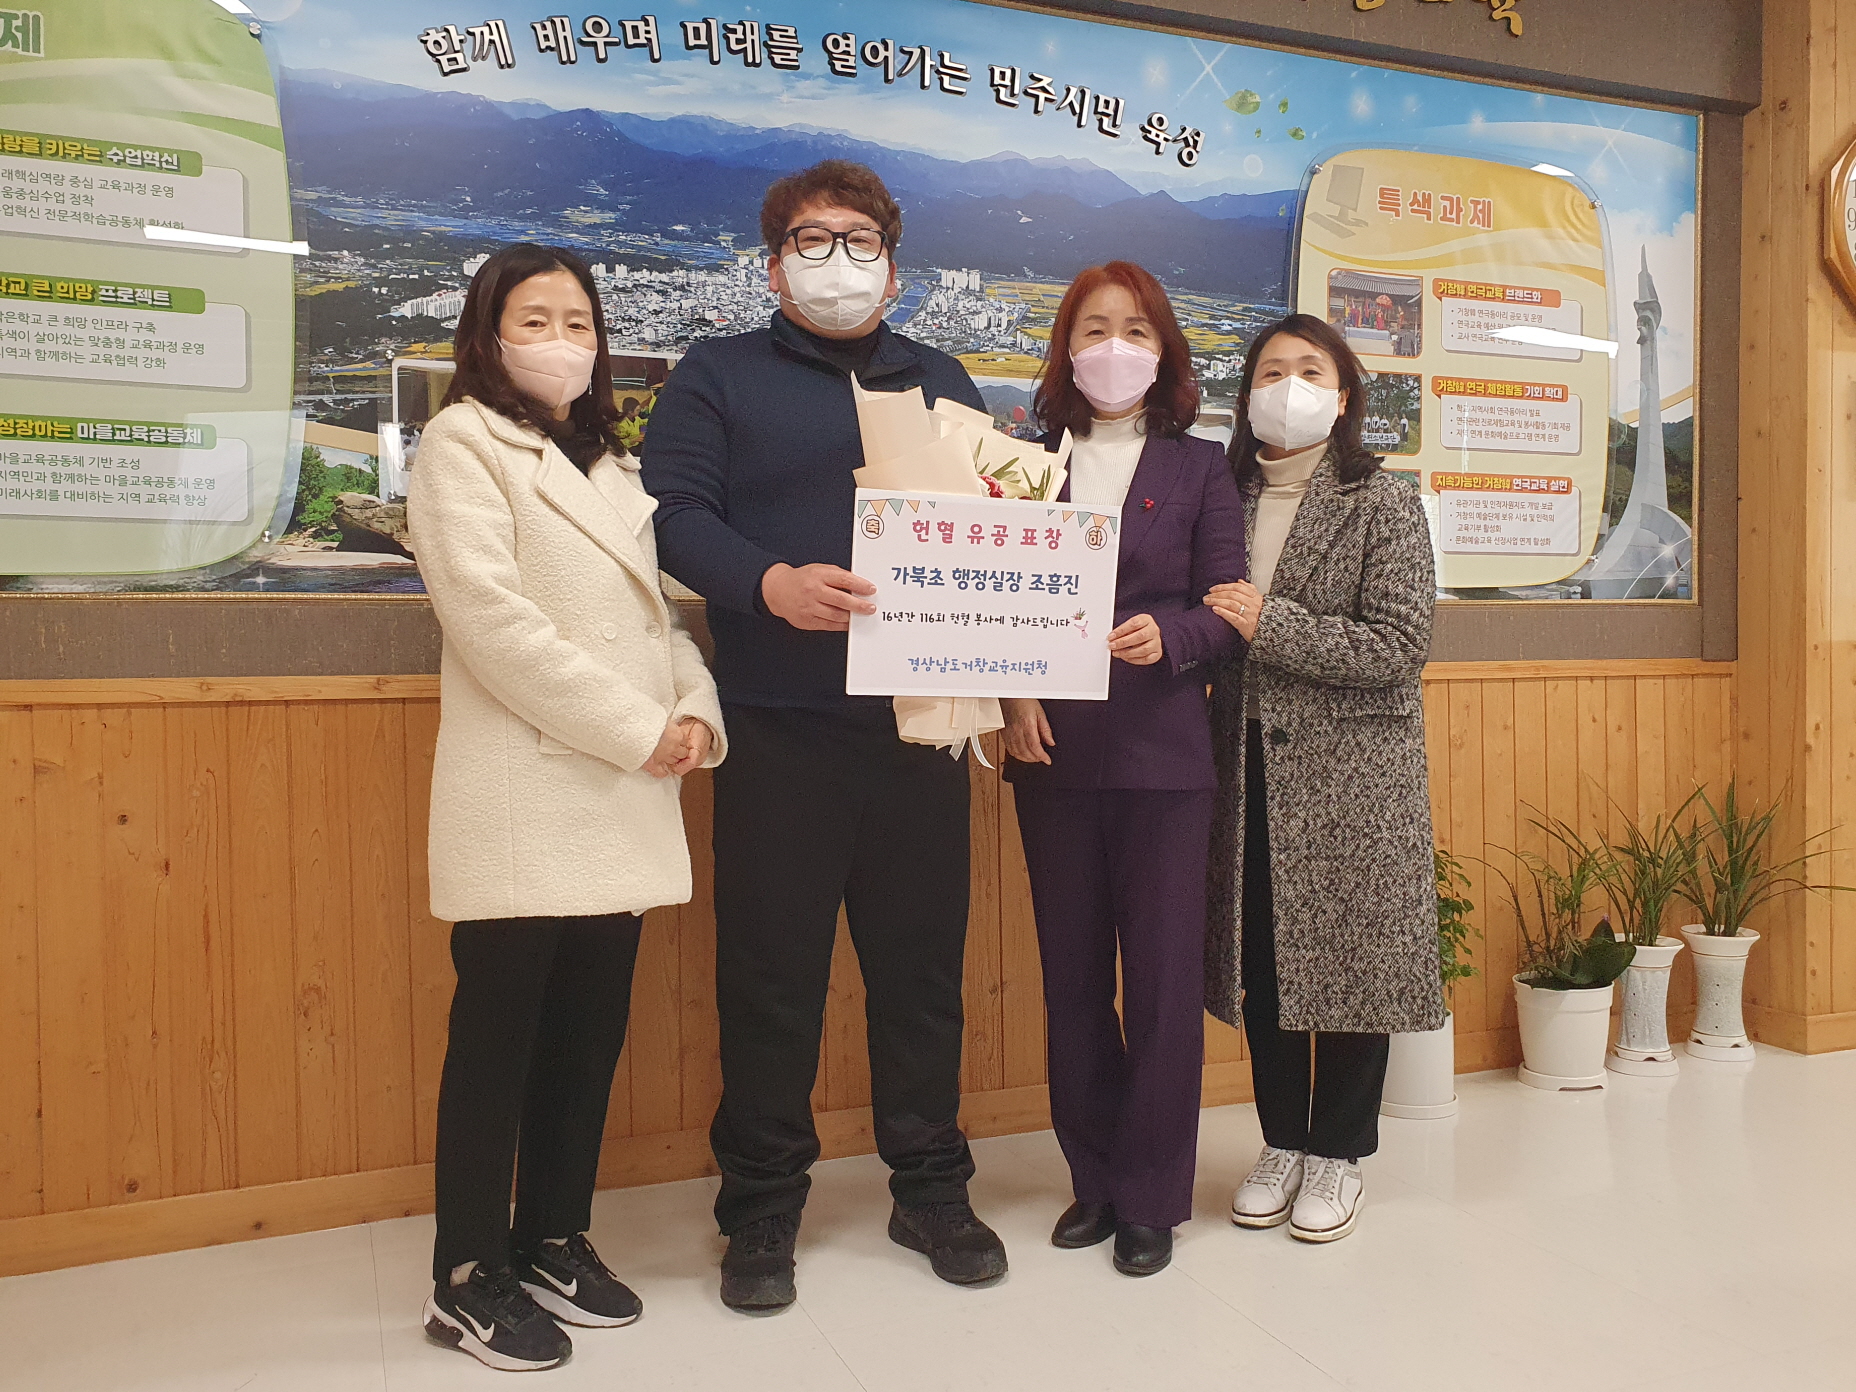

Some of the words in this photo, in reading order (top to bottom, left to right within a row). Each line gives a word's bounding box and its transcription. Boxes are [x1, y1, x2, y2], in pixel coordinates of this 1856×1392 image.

[418, 19, 517, 77] 함께
[530, 14, 662, 65] 배우며
[680, 17, 804, 70] 미래를
[821, 32, 972, 96] 열어가는
[988, 64, 1126, 139] 민주시민
[1139, 111, 1206, 168] 육성
[0, 133, 40, 155] 량을
[45, 139, 101, 161] 키우는
[106, 146, 179, 170] 수업혁신
[68, 175, 94, 190] 중심
[97, 178, 147, 195] 교육과정
[150, 184, 175, 198] 운영
[69, 193, 95, 207] 정착
[1377, 185, 1493, 230] 특색과제
[0, 203, 40, 220] 업혁신
[44, 208, 145, 230] 전문적학습공동체
[32, 279, 52, 296] 큰
[56, 281, 94, 300] 희망
[99, 285, 172, 307] 프로젝트
[1467, 284, 1504, 299] 연극교육
[1505, 288, 1542, 303] 브랜드화
[0, 309, 43, 326] 은학교
[46, 314, 60, 328] 큰
[63, 315, 89, 330] 희망
[91, 318, 129, 333] 인프라
[132, 321, 157, 335] 구축
[0, 328, 30, 344] 색이
[34, 331, 86, 347] 살아있는
[88, 336, 126, 351] 맞춤형
[129, 340, 178, 354] 교육과정
[181, 342, 205, 356] 운영
[35, 349, 87, 365] 함께하는
[89, 353, 139, 368] 교육협력
[142, 356, 167, 370] 강화
[1466, 381, 1485, 394] 연극
[1487, 382, 1523, 397] 체험활동
[1524, 386, 1543, 398] 기회
[1544, 387, 1563, 400] 확대
[77, 422, 202, 445] 마을교육공동체
[1559, 423, 1571, 432] 제공
[88, 455, 113, 469] 기반
[116, 457, 140, 470] 조성
[50, 471, 101, 487] 함께하는
[104, 475, 189, 490] 마을교육공동체
[192, 477, 216, 491] 운영
[1436, 475, 1482, 489] 지속가능한
[1512, 478, 1548, 491] 연극교육
[1549, 479, 1568, 492] 실현
[64, 489, 115, 504] 대비하는
[117, 492, 142, 505] 지역
[144, 493, 180, 506] 교육력
[184, 494, 208, 507] 향상
[865, 519, 882, 536] 축
[911, 519, 955, 545] 헌혈
[966, 523, 1009, 548] 유공
[1020, 527, 1063, 551] 표창
[1087, 529, 1103, 547] 하
[891, 565, 945, 588] 가북초
[952, 567, 1023, 593] 행정실장
[1028, 573, 1080, 596] 조흠진
[882, 610, 916, 623] 16년간
[919, 612, 946, 624] 116회
[950, 612, 971, 627] 헌혈
[974, 614, 1006, 628] 봉사에
[1009, 614, 1071, 629] 감사드립니다
[907, 656, 1049, 677] 경상남도거창교육지원청
